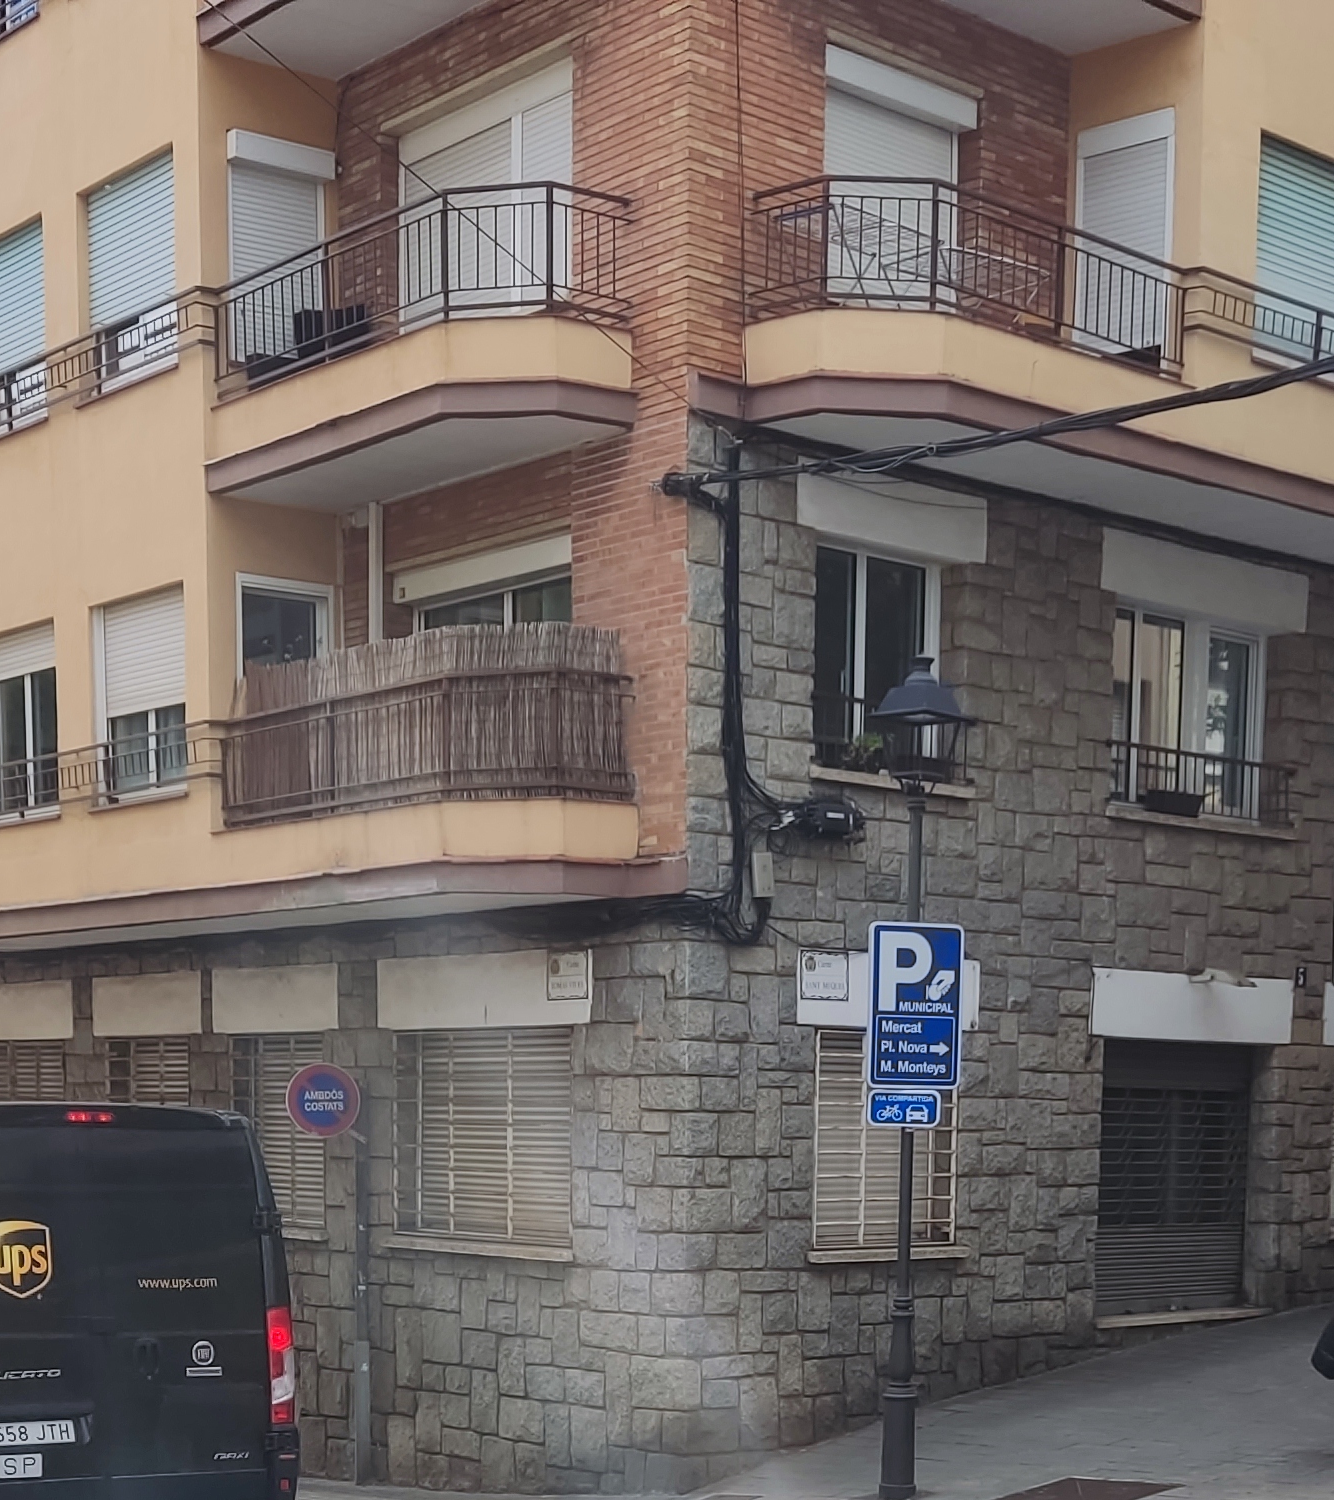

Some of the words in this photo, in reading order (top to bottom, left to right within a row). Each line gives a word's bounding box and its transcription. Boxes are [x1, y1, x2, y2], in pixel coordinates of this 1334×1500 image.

[878, 930, 933, 1012] P
[898, 1001, 954, 1014] MUNICIPAL
[881, 1020, 922, 1034] Mercat
[880, 1040, 896, 1053] Pl.
[898, 1040, 927, 1053] Nova
[880, 1060, 895, 1073] M.
[897, 1061, 947, 1076] Monteys
[304, 1088, 344, 1100] AMBDÓS
[304, 1101, 344, 1111] COSTATS
[137, 1277, 218, 1291] www.ups.com
[36, 1422, 72, 1442] JTH
